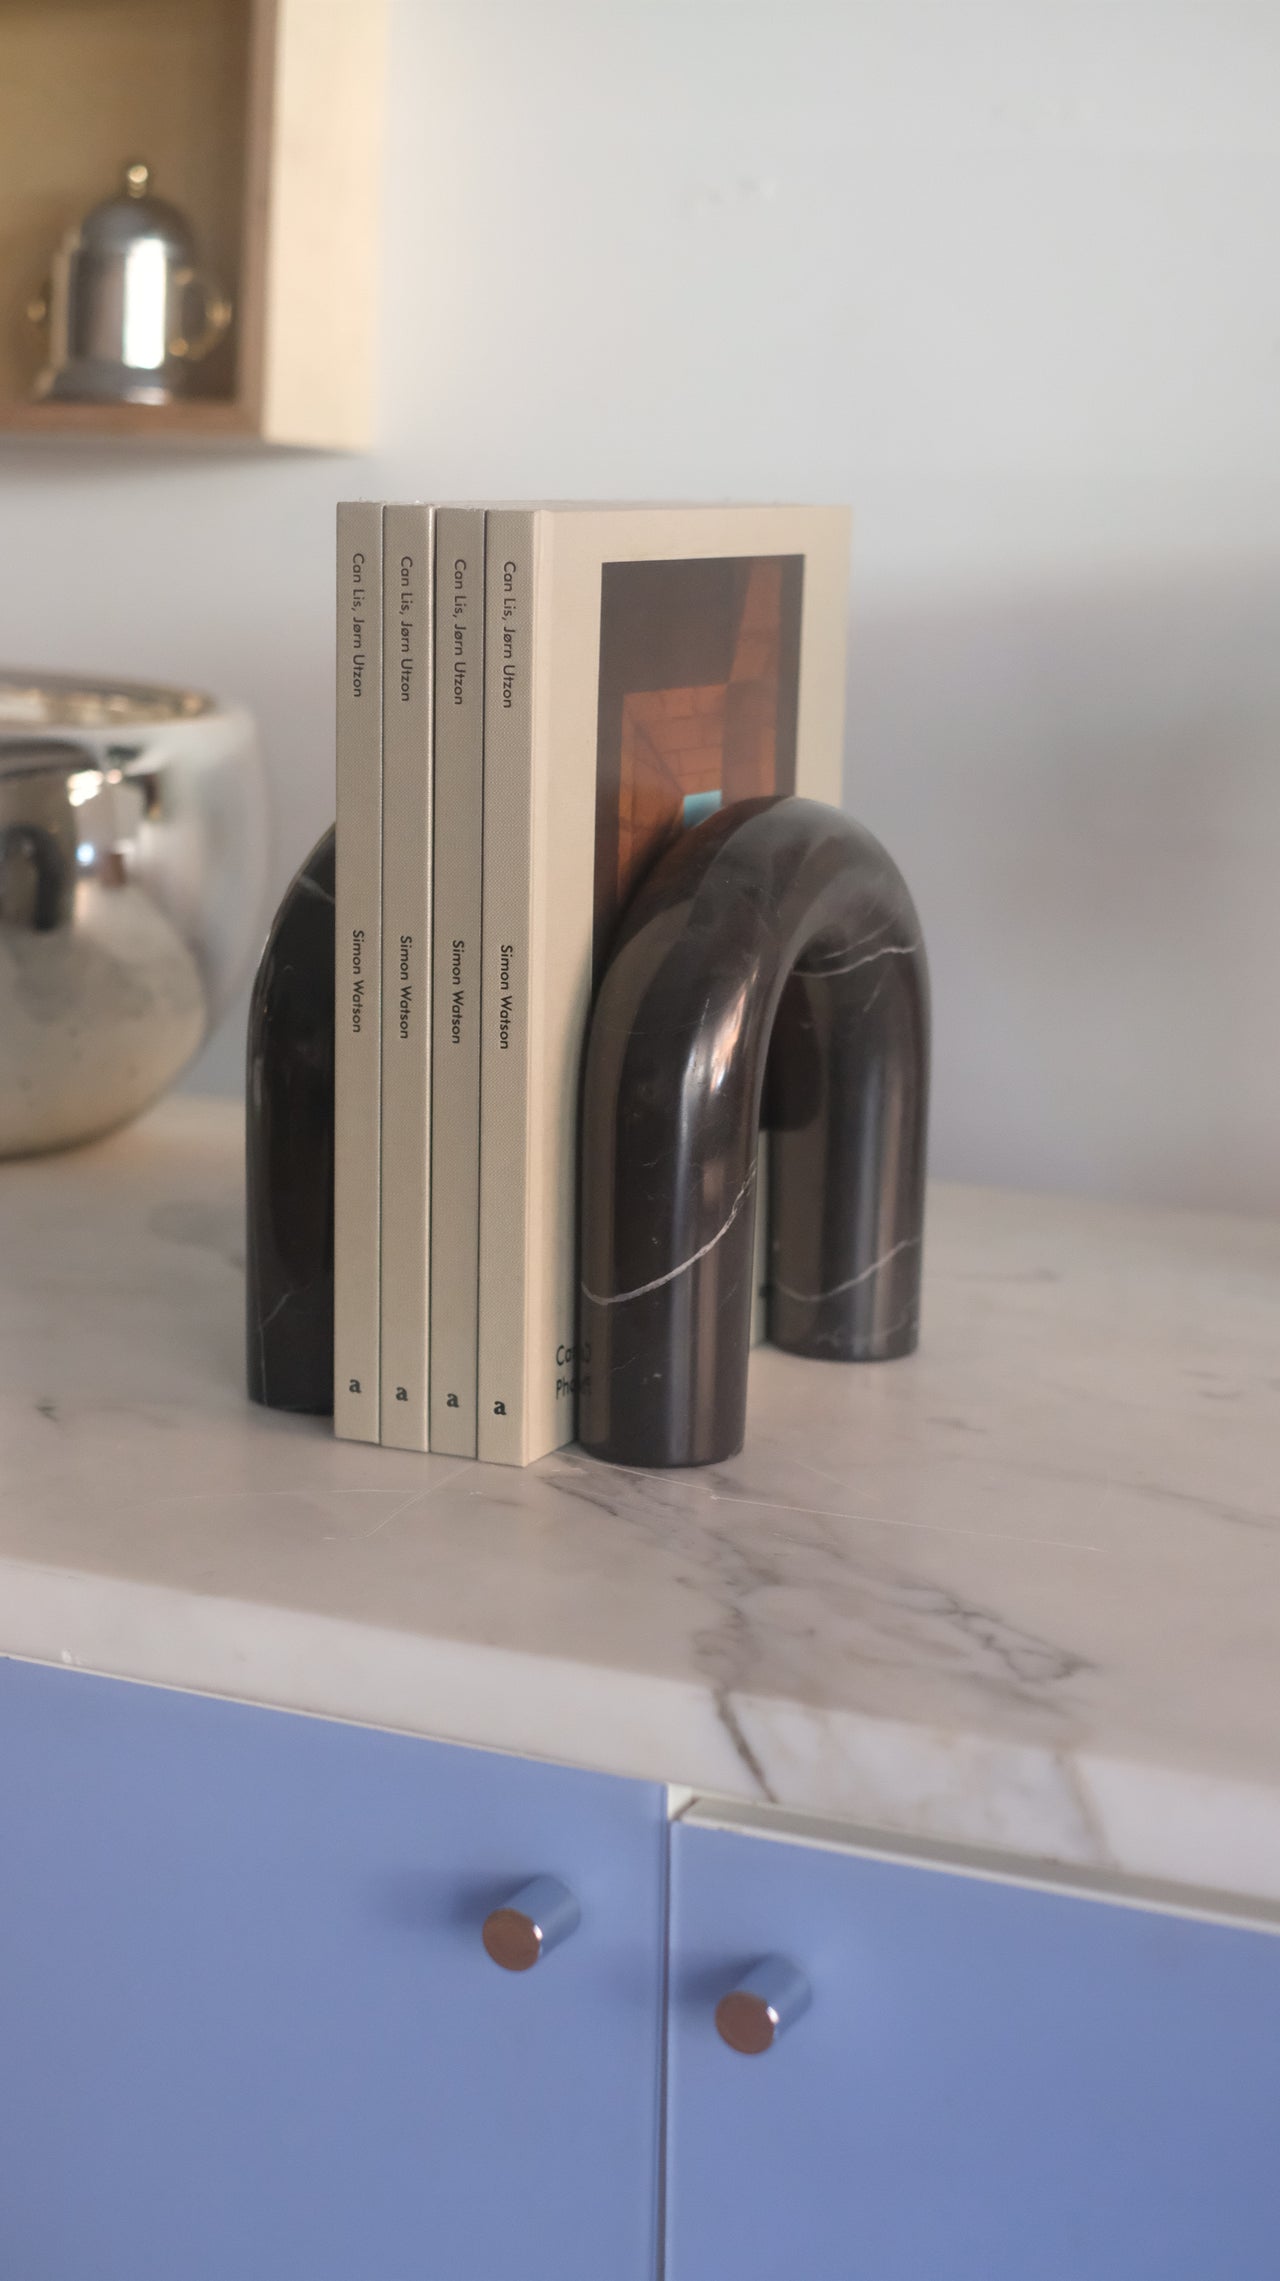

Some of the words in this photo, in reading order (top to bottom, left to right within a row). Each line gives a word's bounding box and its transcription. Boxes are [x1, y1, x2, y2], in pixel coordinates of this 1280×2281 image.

[352, 552, 365, 583] Can
[400, 556, 413, 587] Can
[454, 559, 467, 590] Can
[503, 561, 517, 592] Can
[351, 588, 365, 612] Lis,
[399, 592, 413, 615] Lis,
[452, 595, 467, 618] Lis,
[501, 598, 517, 621] Lis,
[352, 616, 365, 649] Jørn
[400, 620, 413, 653] Jørn
[454, 623, 467, 656] Jørn
[503, 626, 516, 659] Jørn
[352, 654, 365, 698] Utzon
[400, 658, 413, 702] Utzon
[454, 661, 466, 705] Utzon
[502, 664, 516, 708] Utzon
[352, 930, 365, 975] Simon
[400, 935, 413, 981] Simon
[452, 940, 465, 985] Simon
[500, 944, 514, 990] Simon
[352, 979, 364, 1033] Watson
[399, 985, 412, 1039] Watson
[451, 990, 464, 1044] Watson
[499, 995, 513, 1050] Watson
[348, 1379, 362, 1394] a
[395, 1386, 409, 1402] a
[446, 1393, 460, 1408] a
[493, 1400, 507, 1416] a
